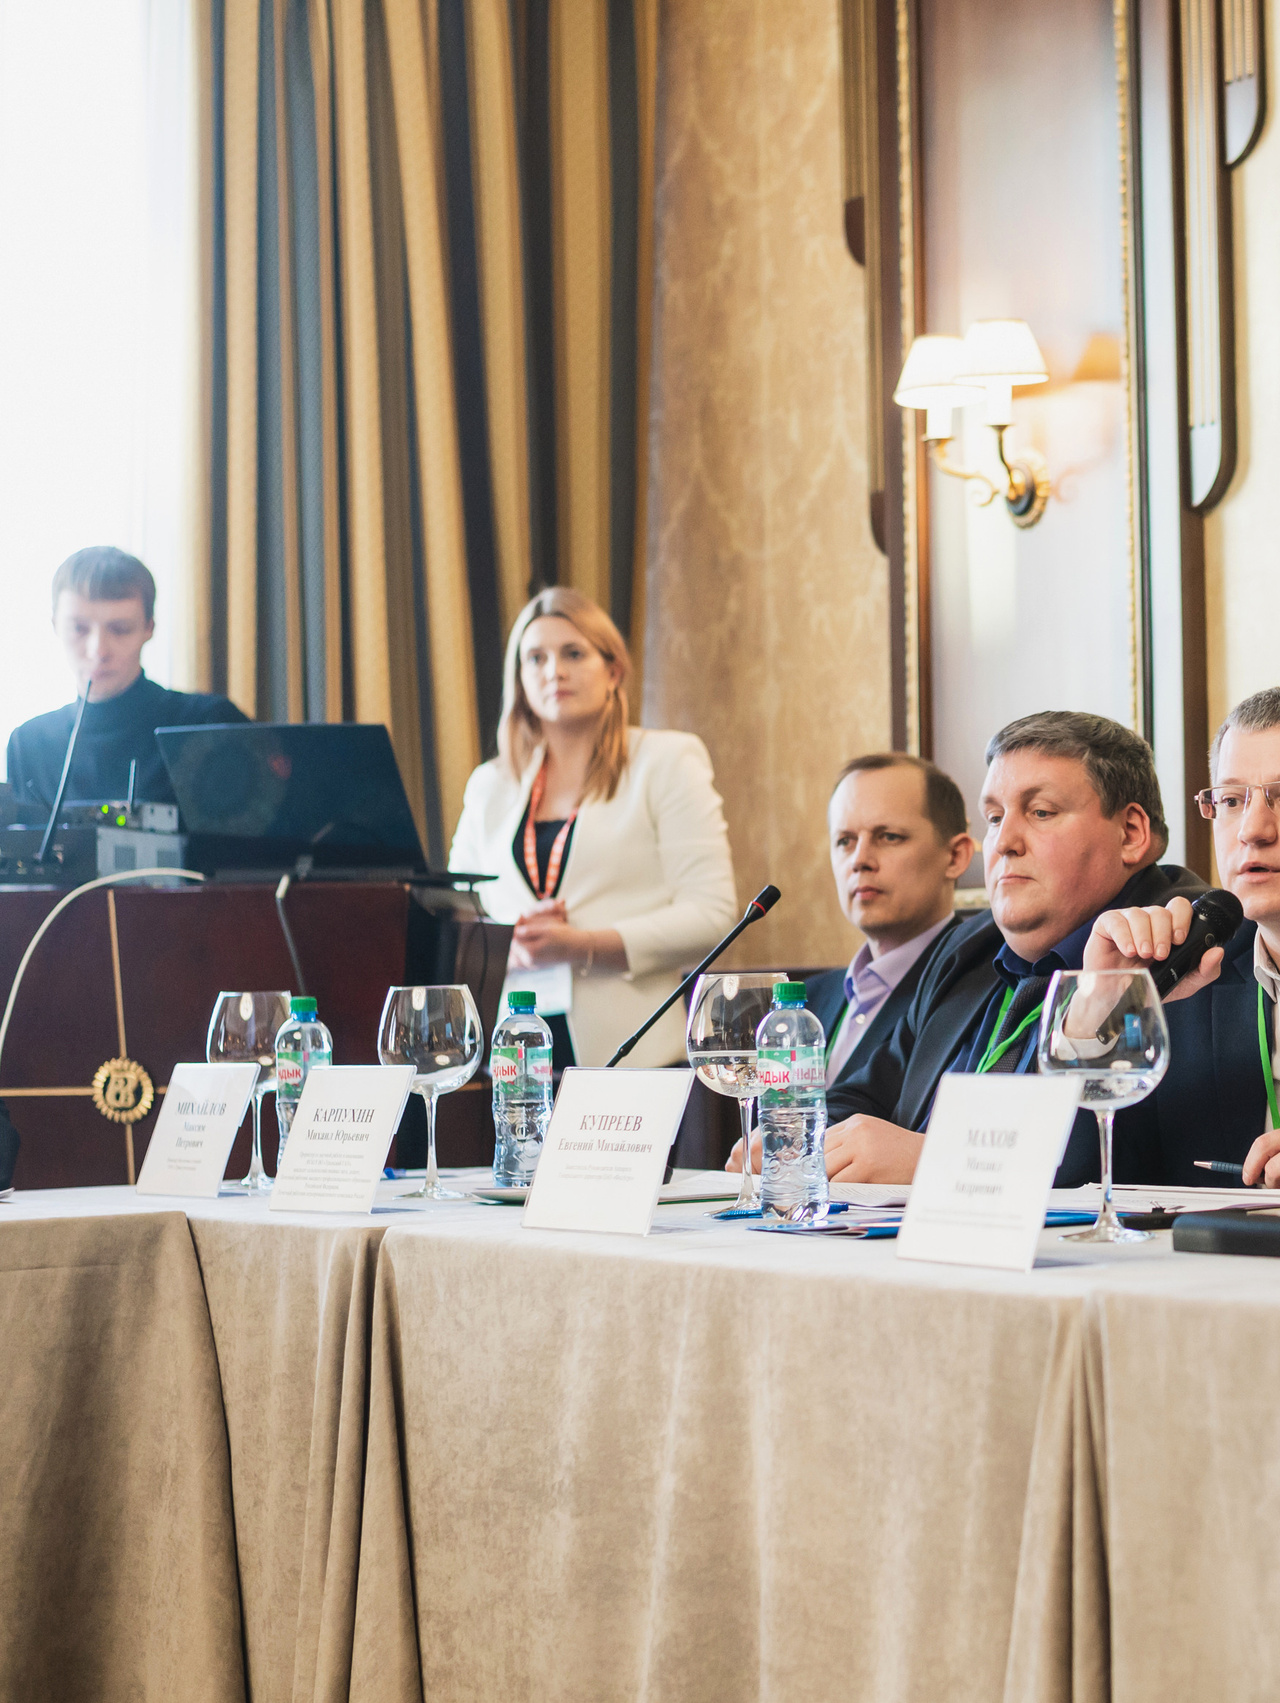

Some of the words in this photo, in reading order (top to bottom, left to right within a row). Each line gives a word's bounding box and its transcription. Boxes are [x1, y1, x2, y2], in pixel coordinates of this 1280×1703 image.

[176, 1099, 227, 1116] МИХАЙЛОВ
[313, 1108, 374, 1123] КАРПУХИН
[580, 1115, 643, 1132] КУПРЕЕВ
[334, 1130, 370, 1144] Юрьевич
[558, 1138, 594, 1151] Евгений
[596, 1139, 653, 1153] Михайлович
